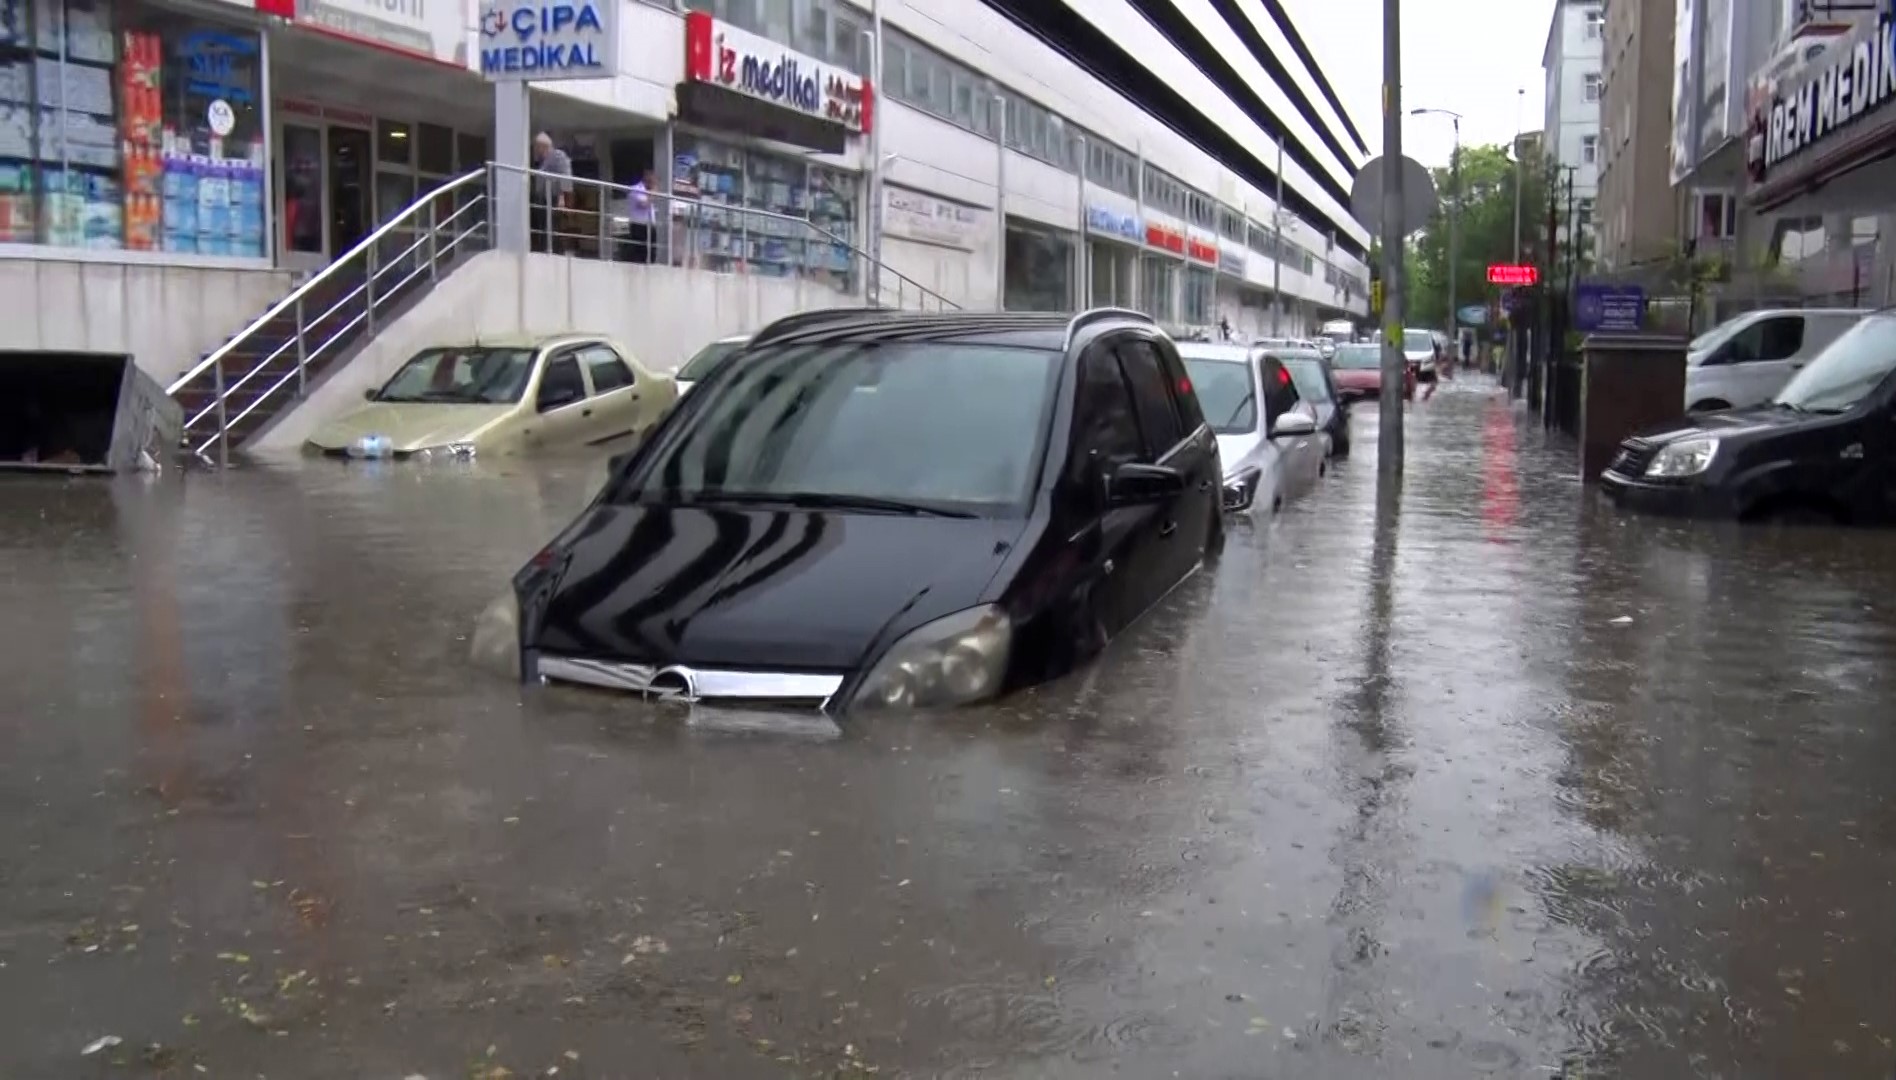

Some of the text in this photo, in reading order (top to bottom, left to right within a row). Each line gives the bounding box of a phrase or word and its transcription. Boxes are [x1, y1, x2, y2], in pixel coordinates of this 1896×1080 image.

[511, 4, 603, 42] ÇIPA
[482, 40, 603, 74] MEDİKAL
[740, 53, 820, 113] medikal
